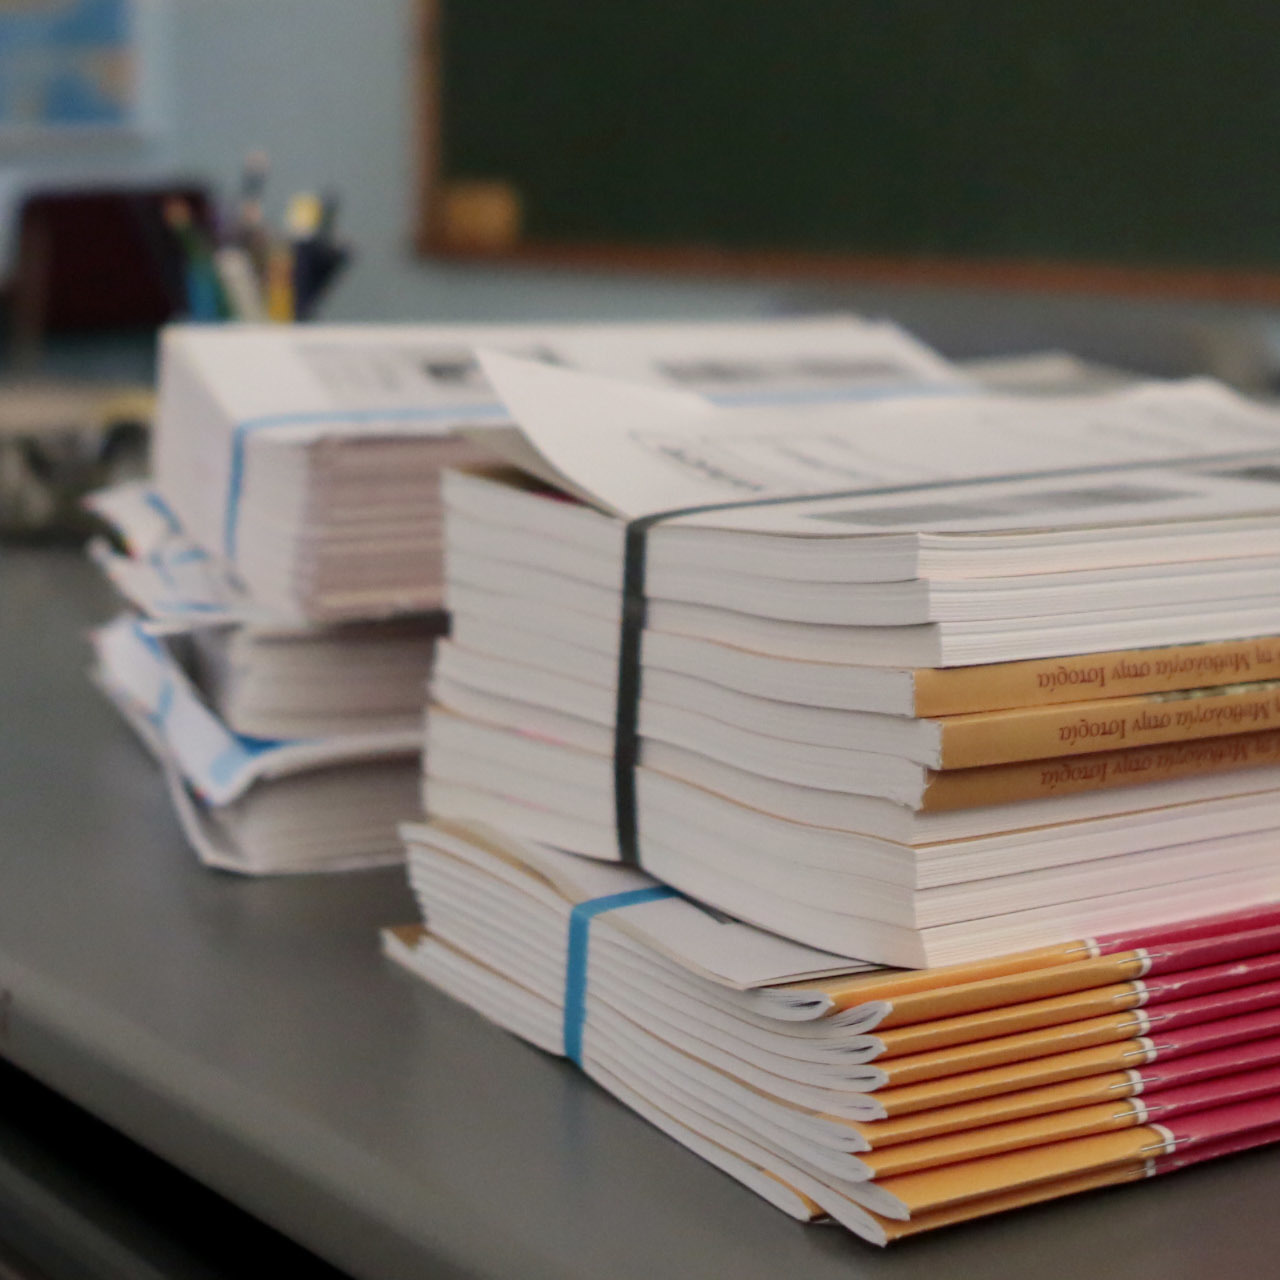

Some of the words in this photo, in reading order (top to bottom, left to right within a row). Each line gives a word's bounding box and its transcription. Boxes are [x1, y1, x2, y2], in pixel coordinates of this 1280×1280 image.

[1037, 666, 1105, 691] Ιστορία
[1111, 658, 1150, 680] στην
[1155, 652, 1250, 680] Μυθολογία
[1132, 711, 1170, 732] στην
[1176, 702, 1269, 730] Μυθολογία
[1059, 719, 1126, 745] Ιστορία
[1041, 763, 1108, 789] Ιστορία
[1113, 754, 1153, 775] στην
